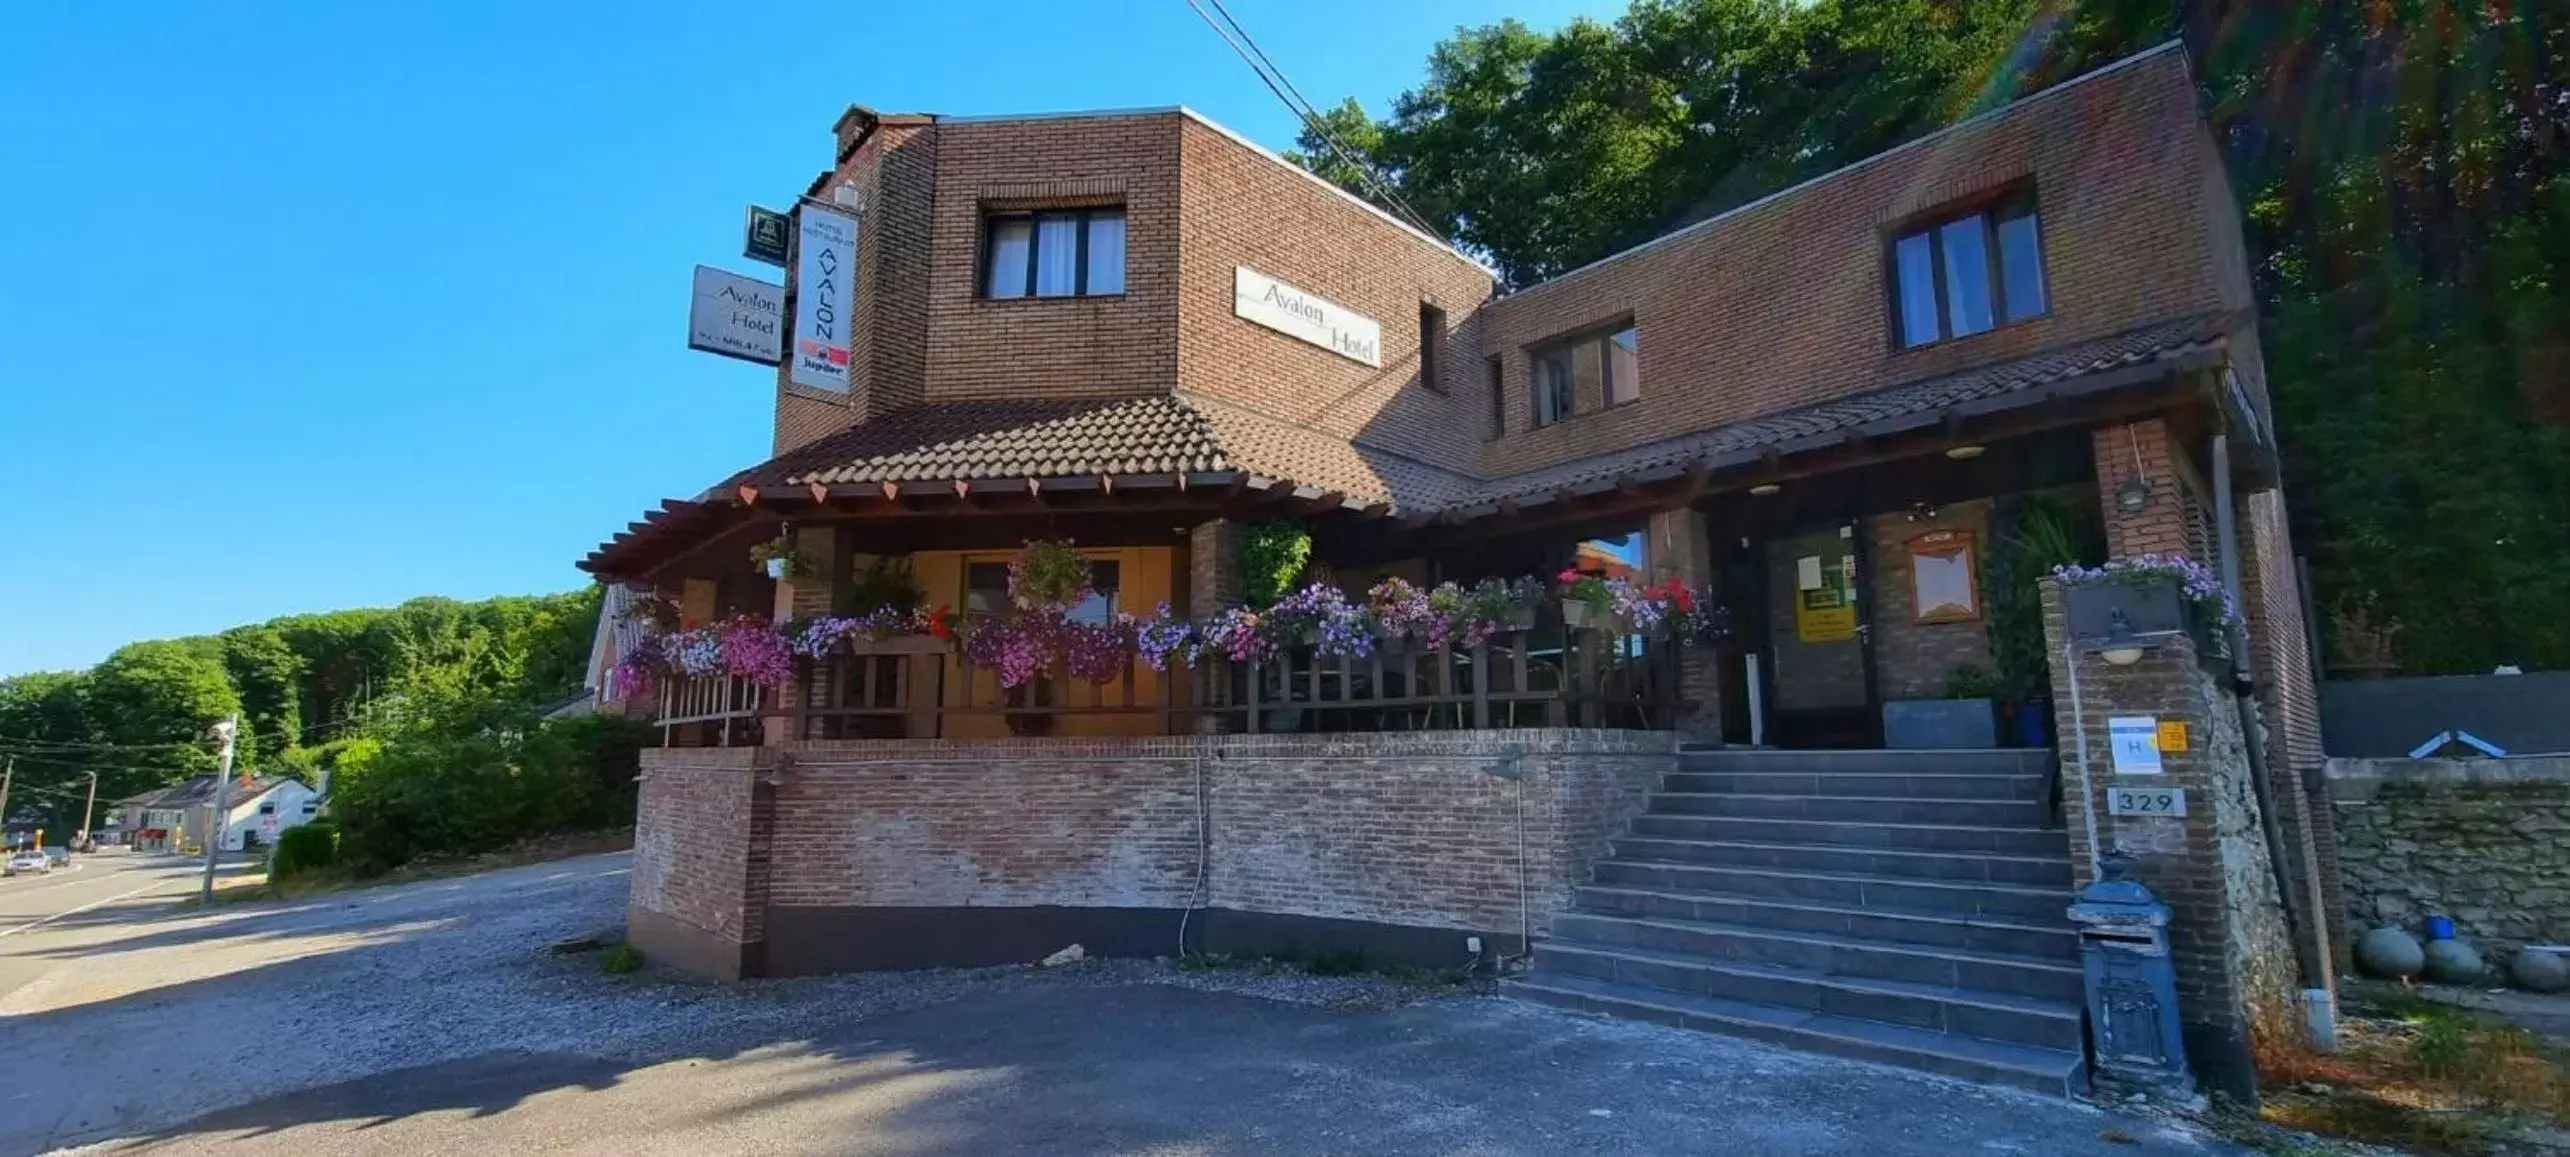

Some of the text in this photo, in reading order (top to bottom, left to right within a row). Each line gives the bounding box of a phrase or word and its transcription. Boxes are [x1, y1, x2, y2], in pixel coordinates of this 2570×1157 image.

[720, 286, 777, 312] Avalon
[817, 248, 838, 341] AVALON
[1264, 284, 1324, 323] Avalon
[732, 311, 774, 336] Hotel
[1332, 328, 1374, 361] Hotel
[2128, 740, 2141, 755] H
[2120, 793, 2173, 812] 329
